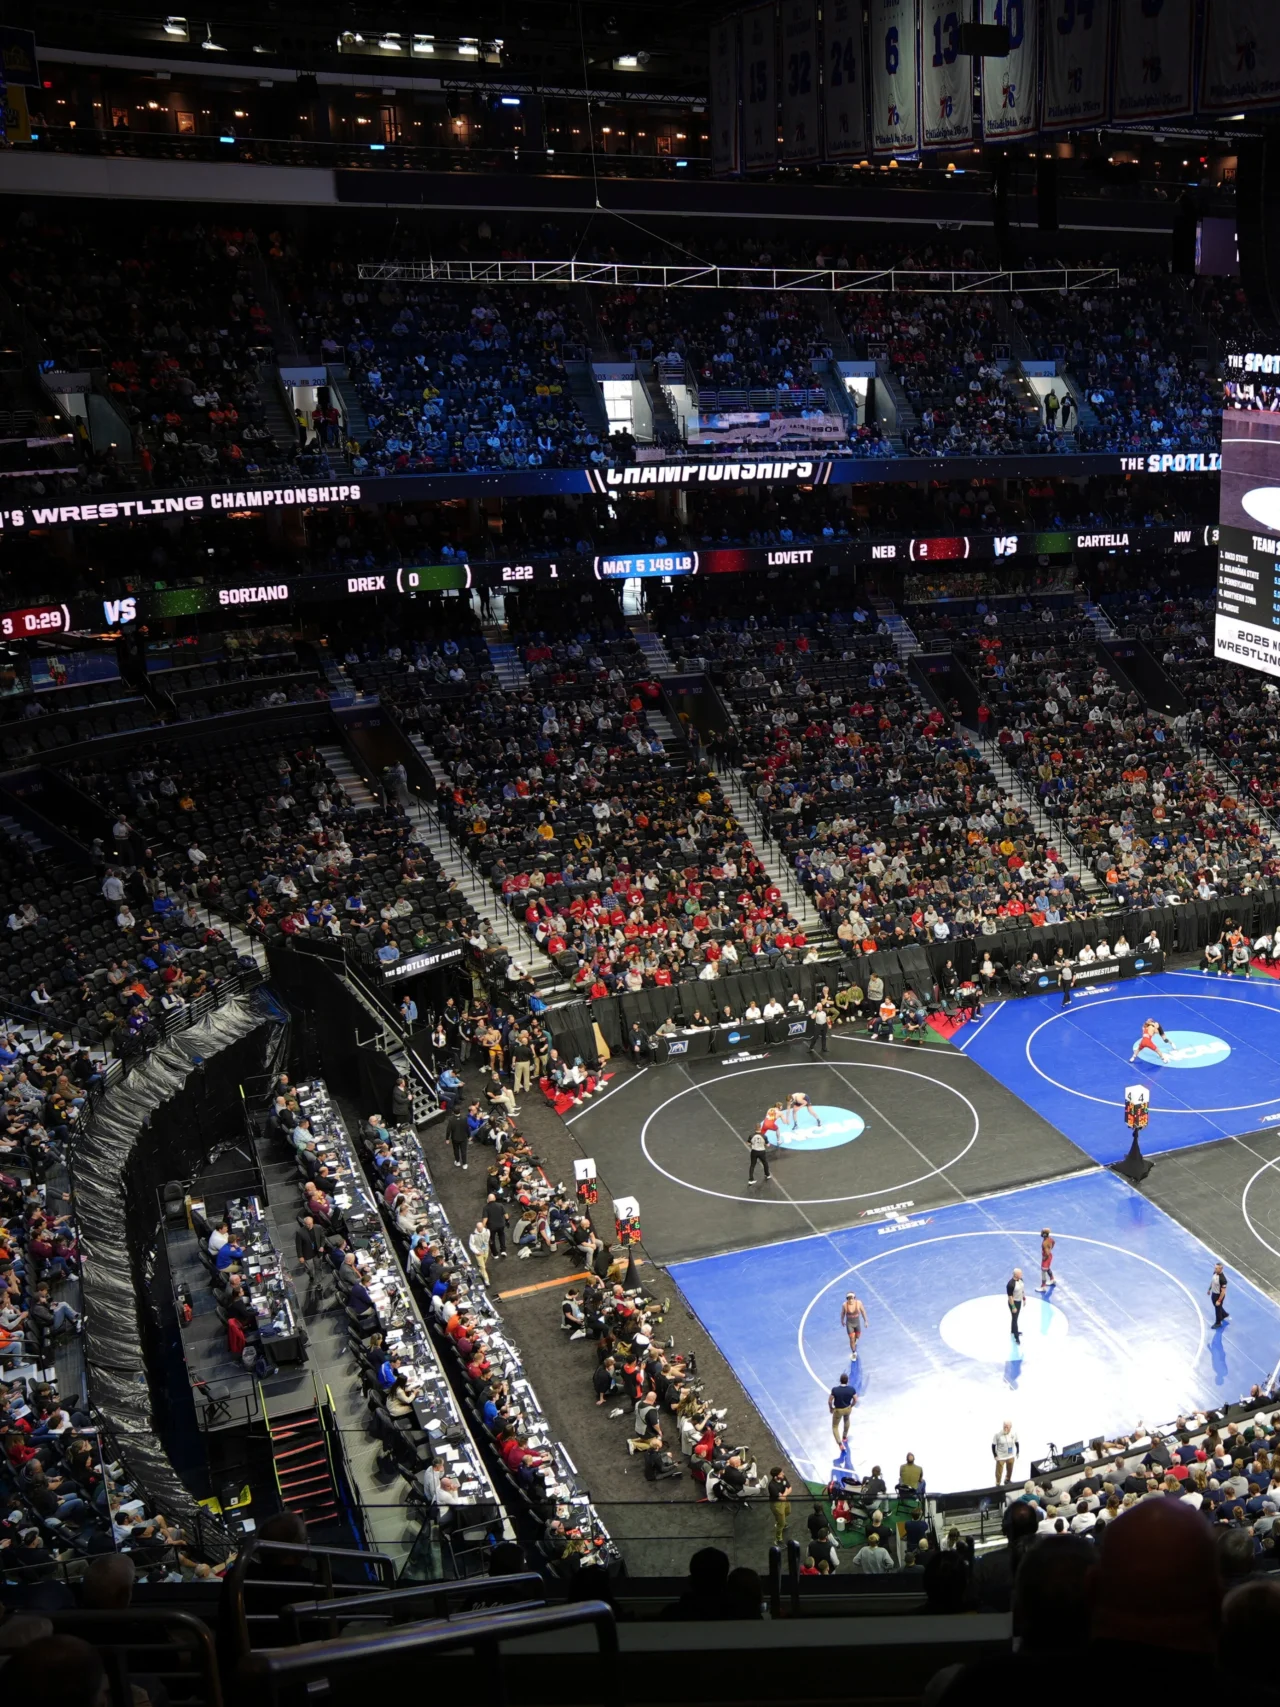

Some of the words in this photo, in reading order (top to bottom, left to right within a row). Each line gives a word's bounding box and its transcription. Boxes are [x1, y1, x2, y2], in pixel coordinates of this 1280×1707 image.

[932, 12, 960, 67] 13
[885, 27, 899, 75] 6
[1228, 355, 1243, 369] THE
[1120, 457, 1145, 471] THE
[1147, 453, 1222, 473] SPOTLI
[0, 510, 25, 530] 'S
[32, 495, 205, 525] WRESTLING
[210, 485, 361, 511] CHAMPIONSHIPS
[994, 535, 1018, 556] VS
[1077, 533, 1129, 549] CARTELLA
[1174, 530, 1191, 543] NW
[1252, 535, 1276, 554] TEAM
[768, 550, 813, 566] LOVETT
[872, 545, 896, 560] NEB
[920, 544, 928, 556] 2
[503, 566, 533, 580] 2:22
[550, 564, 558, 577] 1
[603, 559, 631, 574] MAT
[635, 558, 645, 572] 5
[649, 556, 674, 572] 149
[676, 556, 692, 570] LB
[348, 575, 385, 593] DREX
[408, 573, 419, 586] 0
[219, 585, 288, 605] SORIANO
[103, 597, 137, 627] VS
[2, 619, 13, 635] 3
[25, 611, 61, 631] 0:29
[1238, 630, 1270, 648] 2025
[396, 955, 441, 977] SPOTLIGHT
